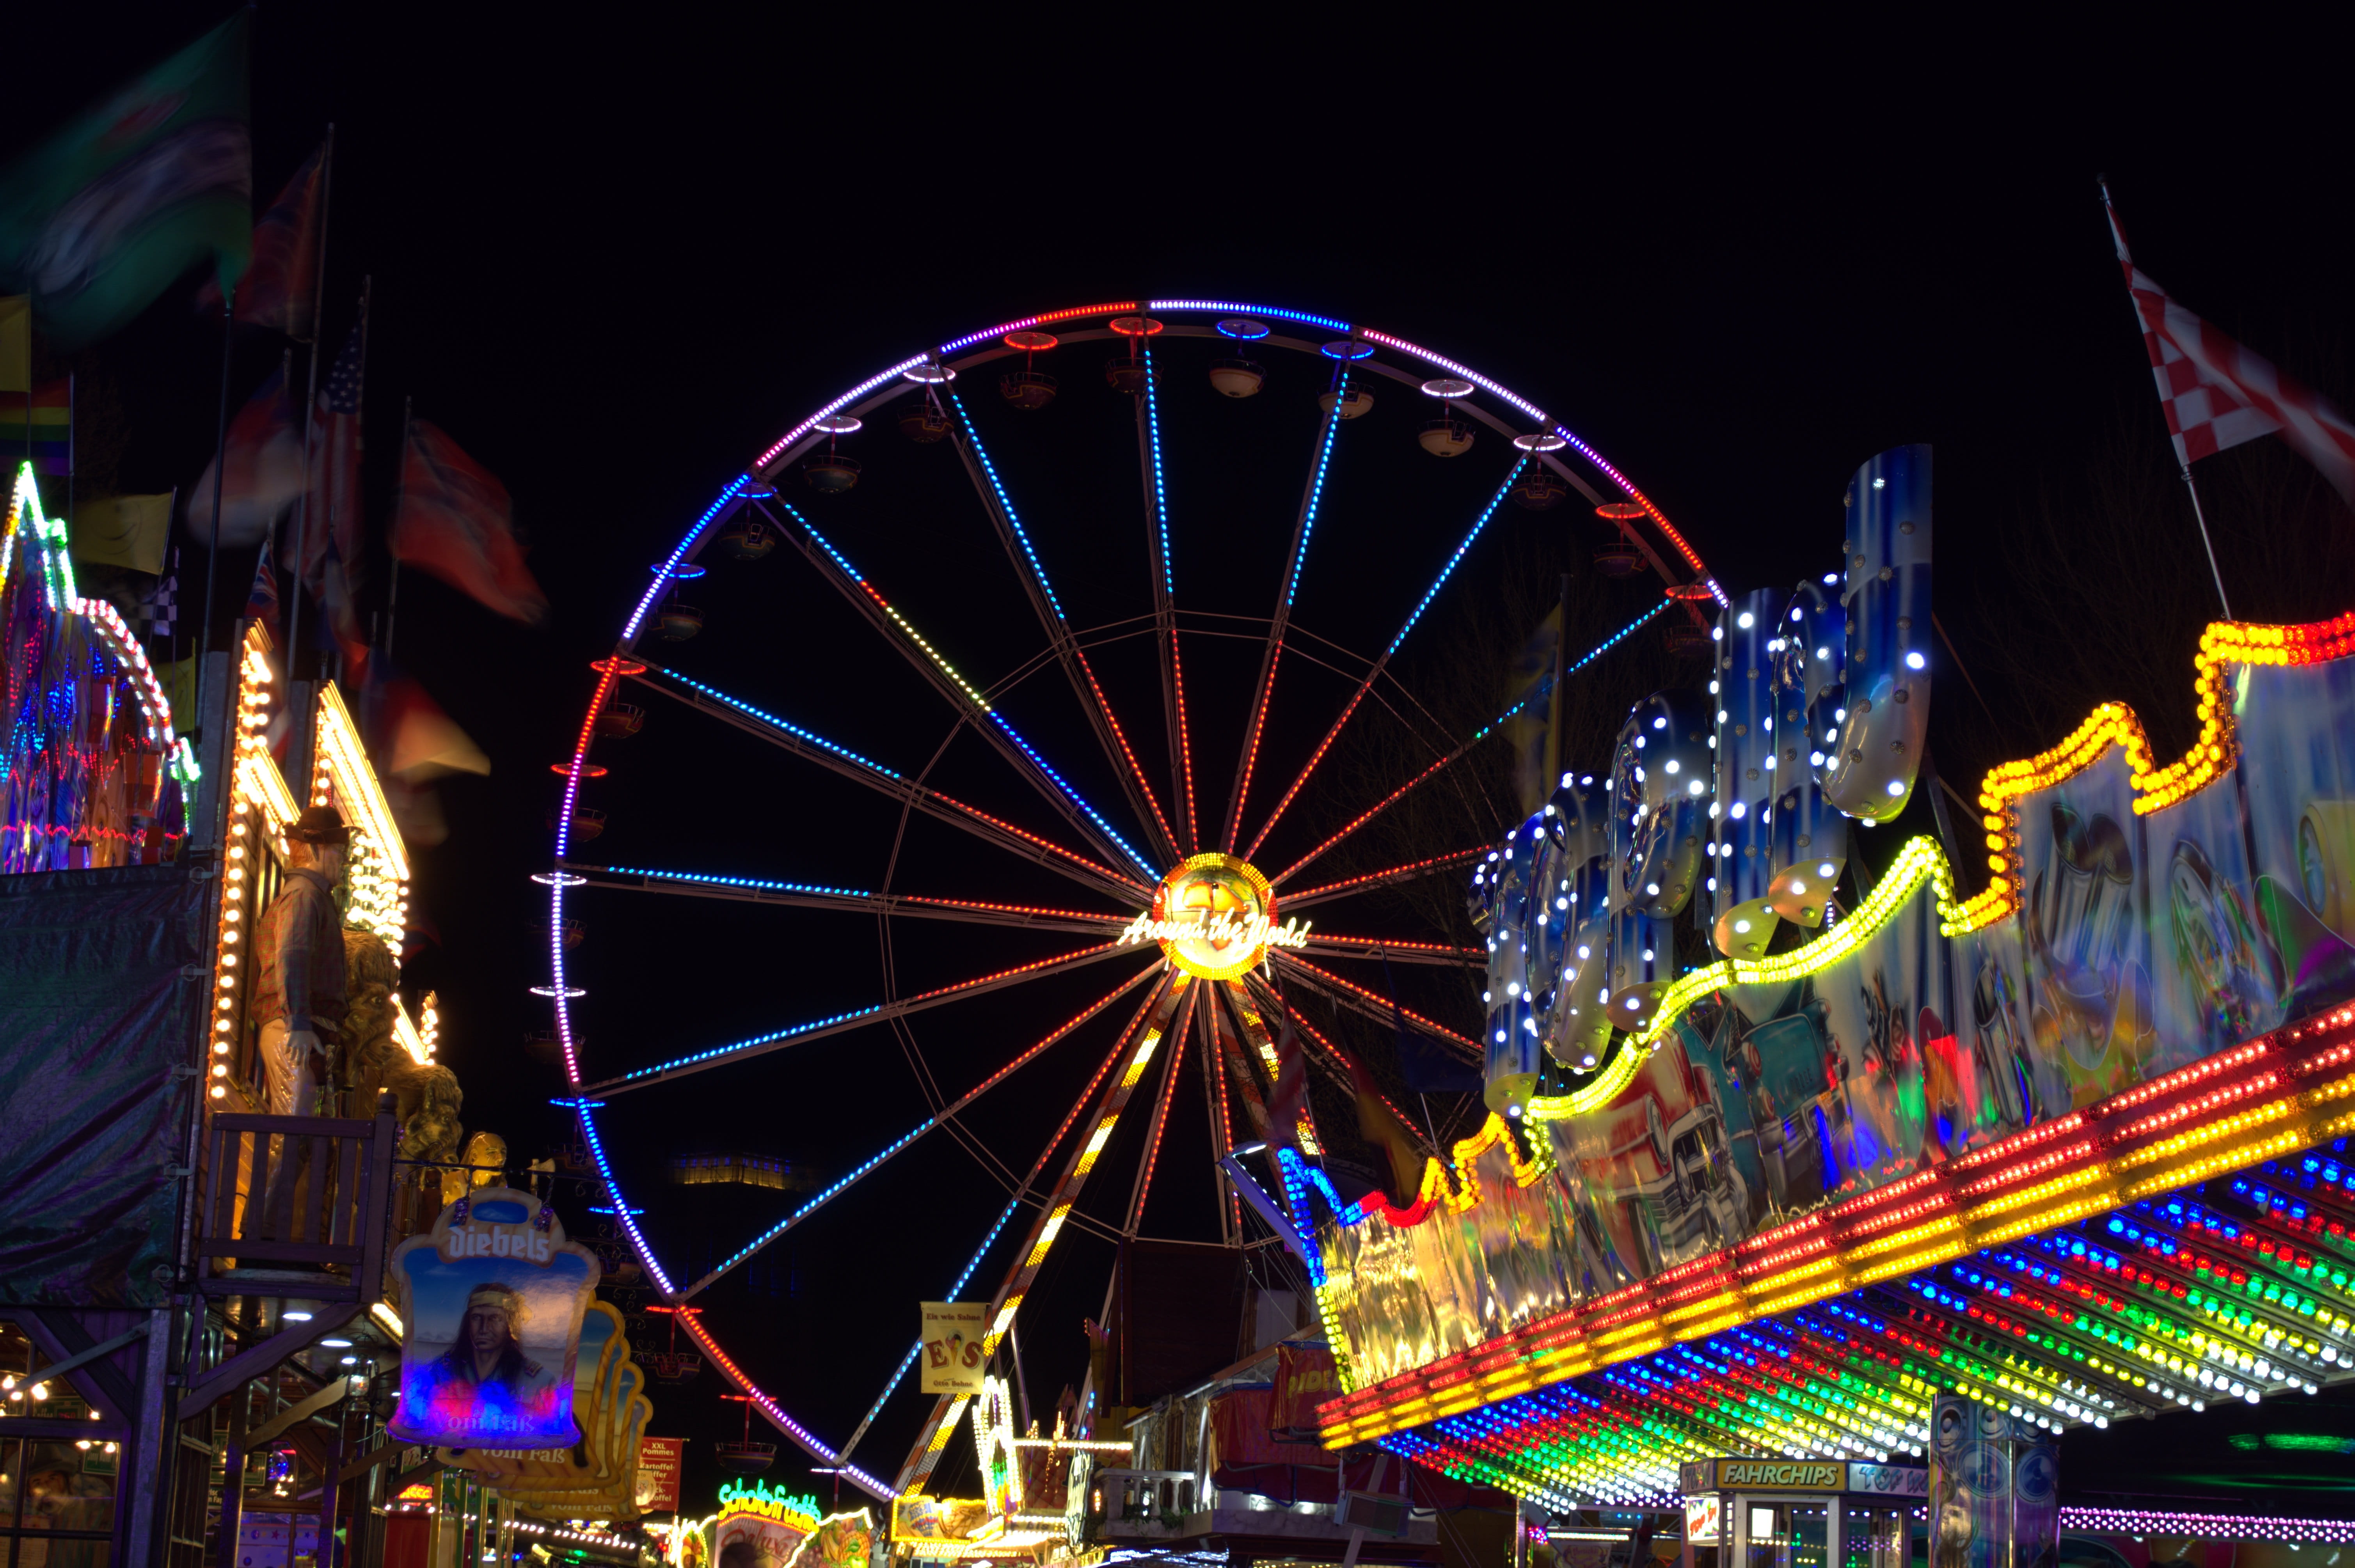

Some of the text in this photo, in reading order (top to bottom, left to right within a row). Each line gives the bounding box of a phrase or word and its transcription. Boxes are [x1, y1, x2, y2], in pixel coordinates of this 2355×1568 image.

[1116, 906, 1312, 948] Around the World
[433, 1411, 535, 1433] Vom Faß
[643, 1447, 675, 1456] Pommes
[1723, 1464, 1839, 1486] FAHRCHIPS
[1859, 1466, 1903, 1491] TOP
[1690, 1513, 1705, 1537] TOP
